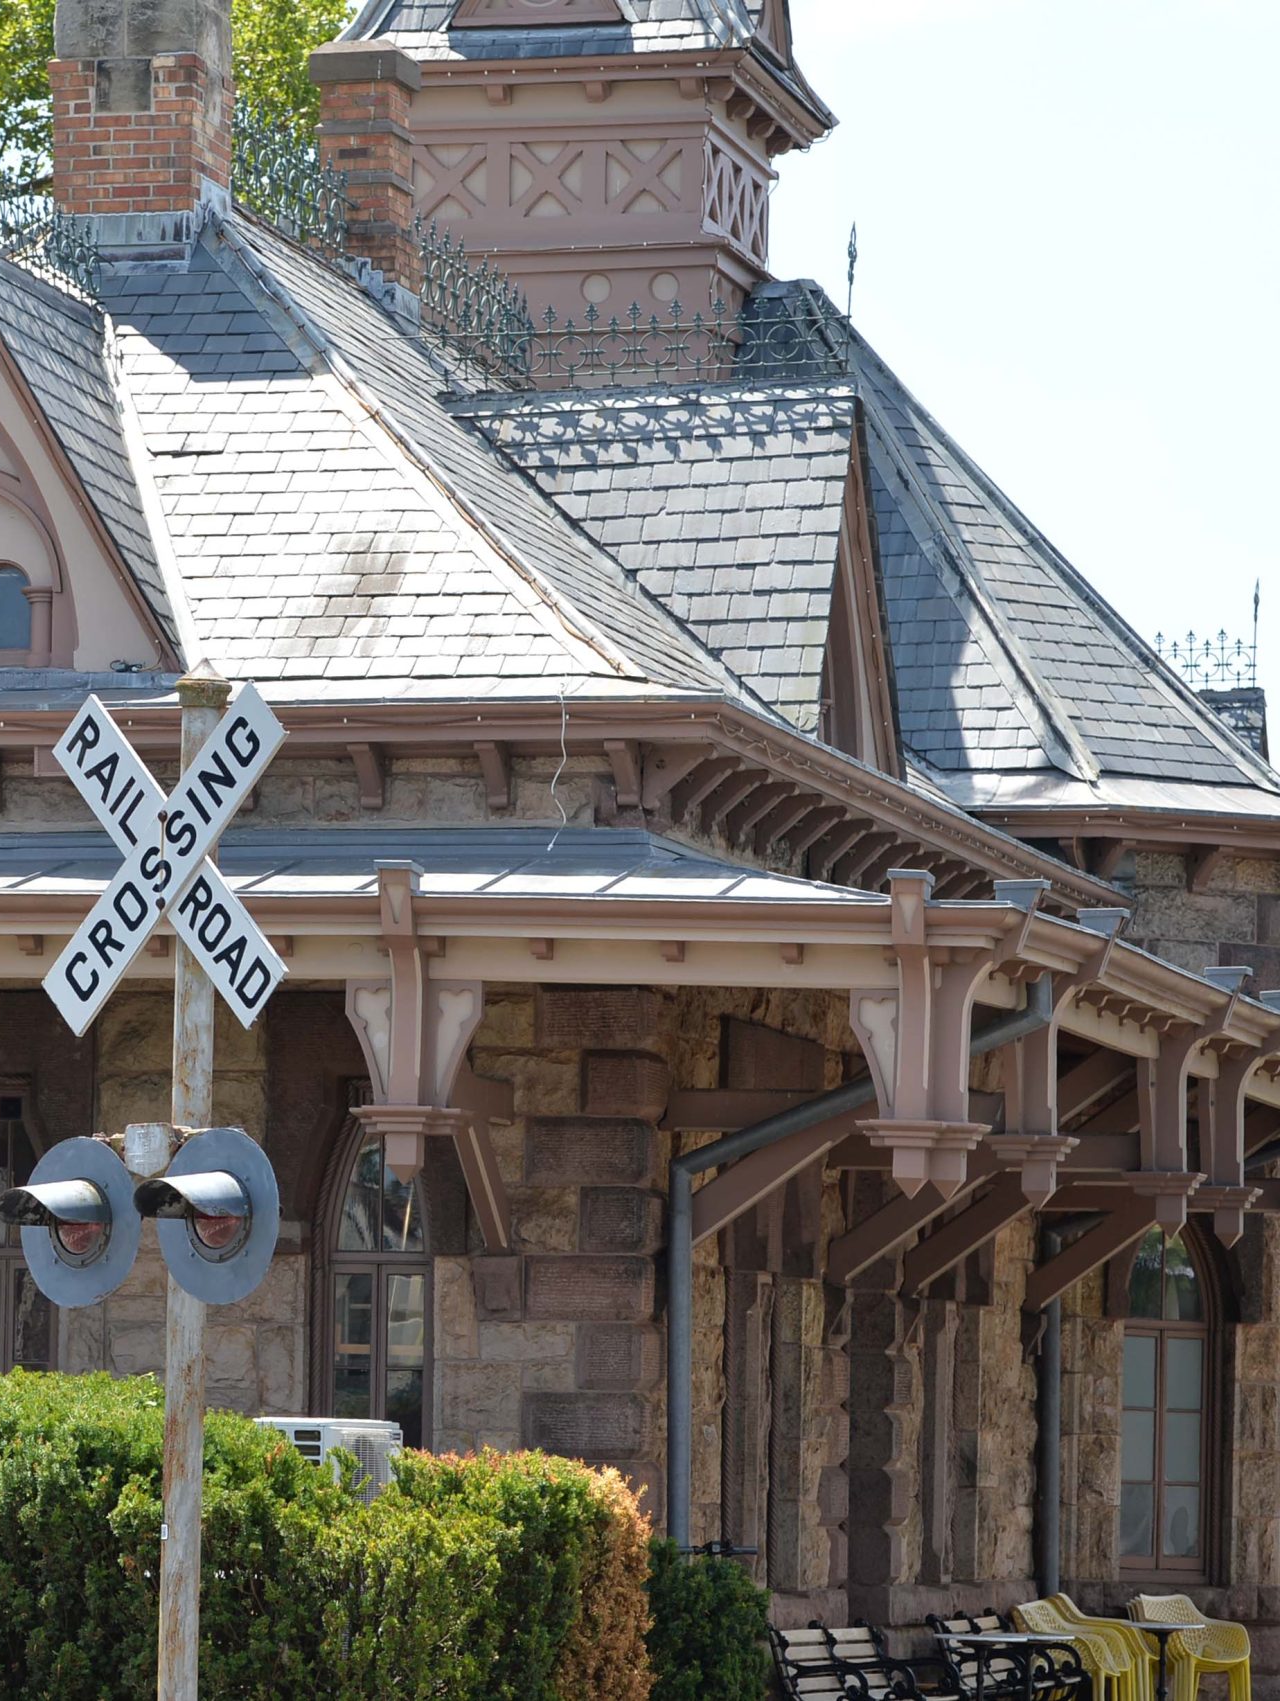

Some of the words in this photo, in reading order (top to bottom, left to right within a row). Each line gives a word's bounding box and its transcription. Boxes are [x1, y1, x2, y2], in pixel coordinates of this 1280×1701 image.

[65, 716, 261, 1002] CROSSING
[66, 714, 145, 846] RAIL
[178, 875, 271, 1009] ROAD
